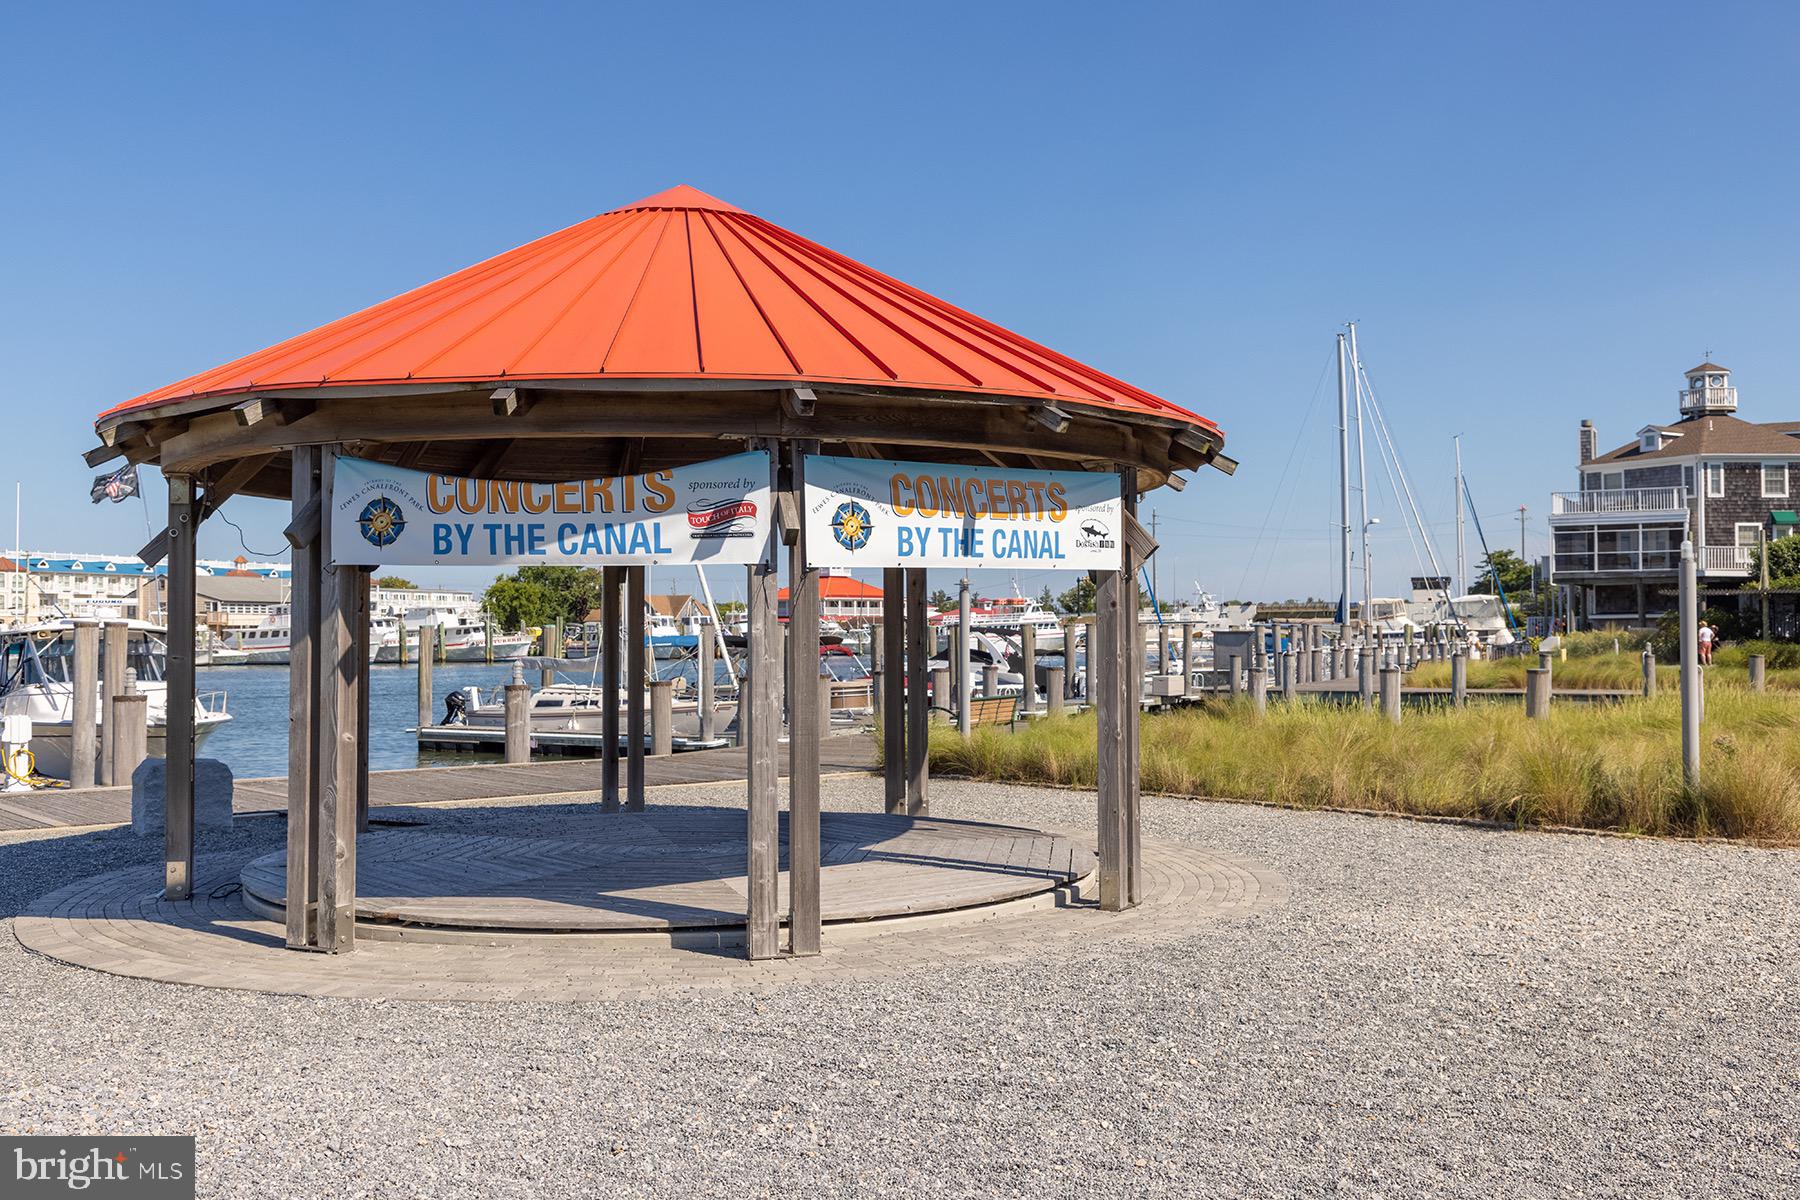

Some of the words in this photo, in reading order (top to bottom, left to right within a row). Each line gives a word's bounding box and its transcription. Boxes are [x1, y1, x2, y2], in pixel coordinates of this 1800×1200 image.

[340, 493, 360, 511] LEWES
[361, 483, 409, 498] CANALFRONT
[408, 496, 424, 511] PARK
[688, 478, 741, 493] sponsored
[743, 477, 756, 492] by
[812, 497, 829, 514] LEWES
[890, 473, 1068, 524] CONCERTS
[1106, 503, 1114, 516] by
[690, 511, 720, 525] TOUCH
[731, 505, 753, 514] ITALY
[433, 523, 475, 555] BY
[483, 523, 547, 555] THE
[557, 522, 673, 555] CANAL
[897, 526, 931, 557] BY
[938, 527, 984, 558] THE
[992, 528, 1066, 559] CANAL
